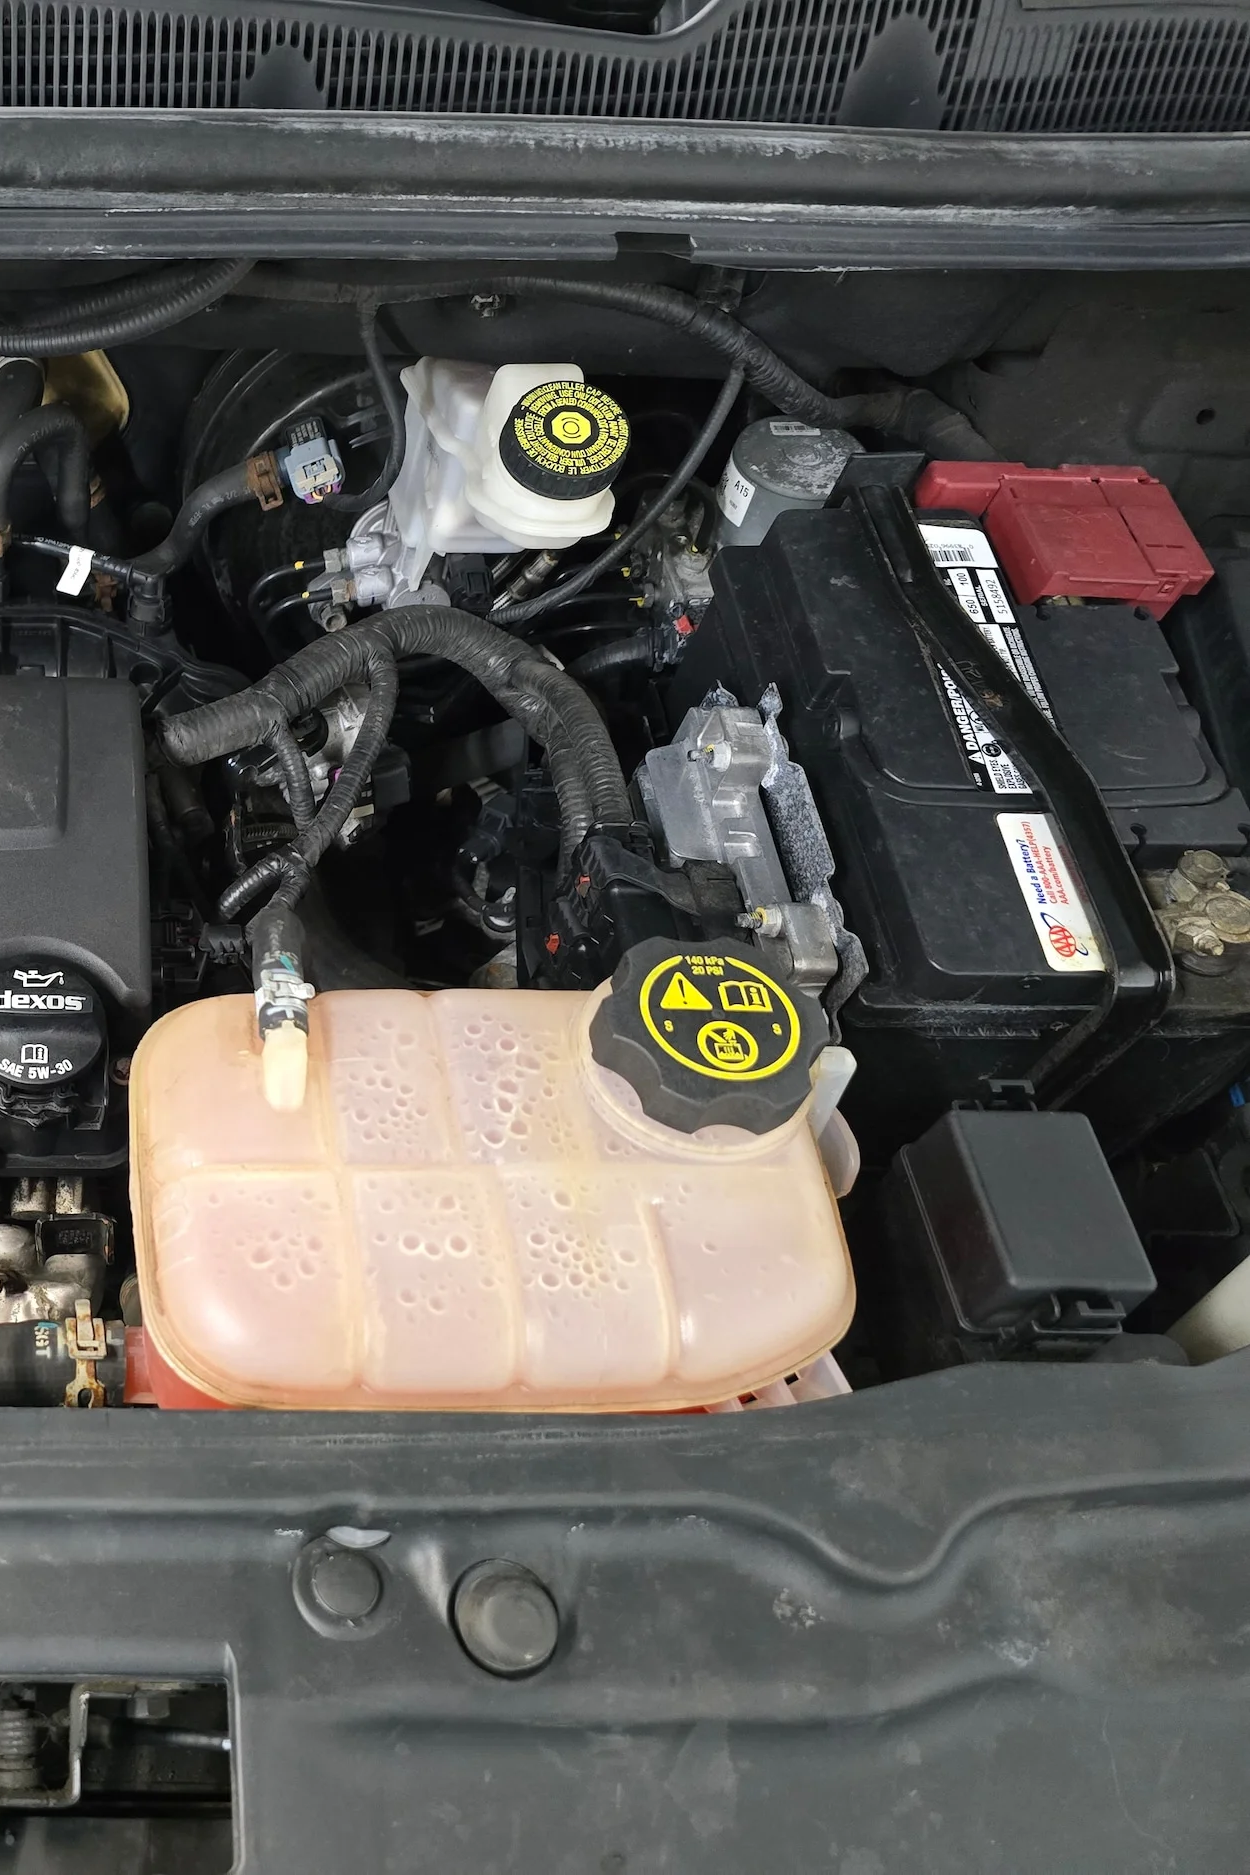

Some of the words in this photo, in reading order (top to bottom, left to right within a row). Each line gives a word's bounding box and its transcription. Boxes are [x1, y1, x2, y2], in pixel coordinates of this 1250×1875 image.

[548, 400, 558, 408] A
[553, 397, 577, 407] SEALED
[557, 389, 573, 397] USE
[573, 389, 590, 401] ONLY
[599, 404, 616, 420] FLUID
[560, 381, 585, 391] FILLER
[584, 385, 602, 398] CAP
[599, 393, 623, 415] BEFORE
[567, 466, 577, 474] LE
[733, 480, 750, 498] A15
[957, 572, 969, 586] 100
[975, 585, 988, 607] SERIAL
[985, 579, 1008, 614] 5158492
[965, 599, 979, 614] 650
[993, 773, 1006, 788] SHIELD
[1000, 763, 1017, 788] EXPLOSIVE
[1015, 838, 1037, 872] Battery?
[1040, 846, 1070, 904] AAA.com/battery
[1030, 882, 1047, 903] Need
[1045, 890, 1058, 903] Call
[1049, 926, 1075, 957] AAA
[685, 955, 703, 966] 140
[705, 955, 725, 967] kPa
[691, 966, 706, 976] 20
[707, 966, 724, 976] PSI
[663, 1019, 674, 1033] S
[771, 1022, 783, 1036] S
[27, 1058, 74, 1080] 5W-30
